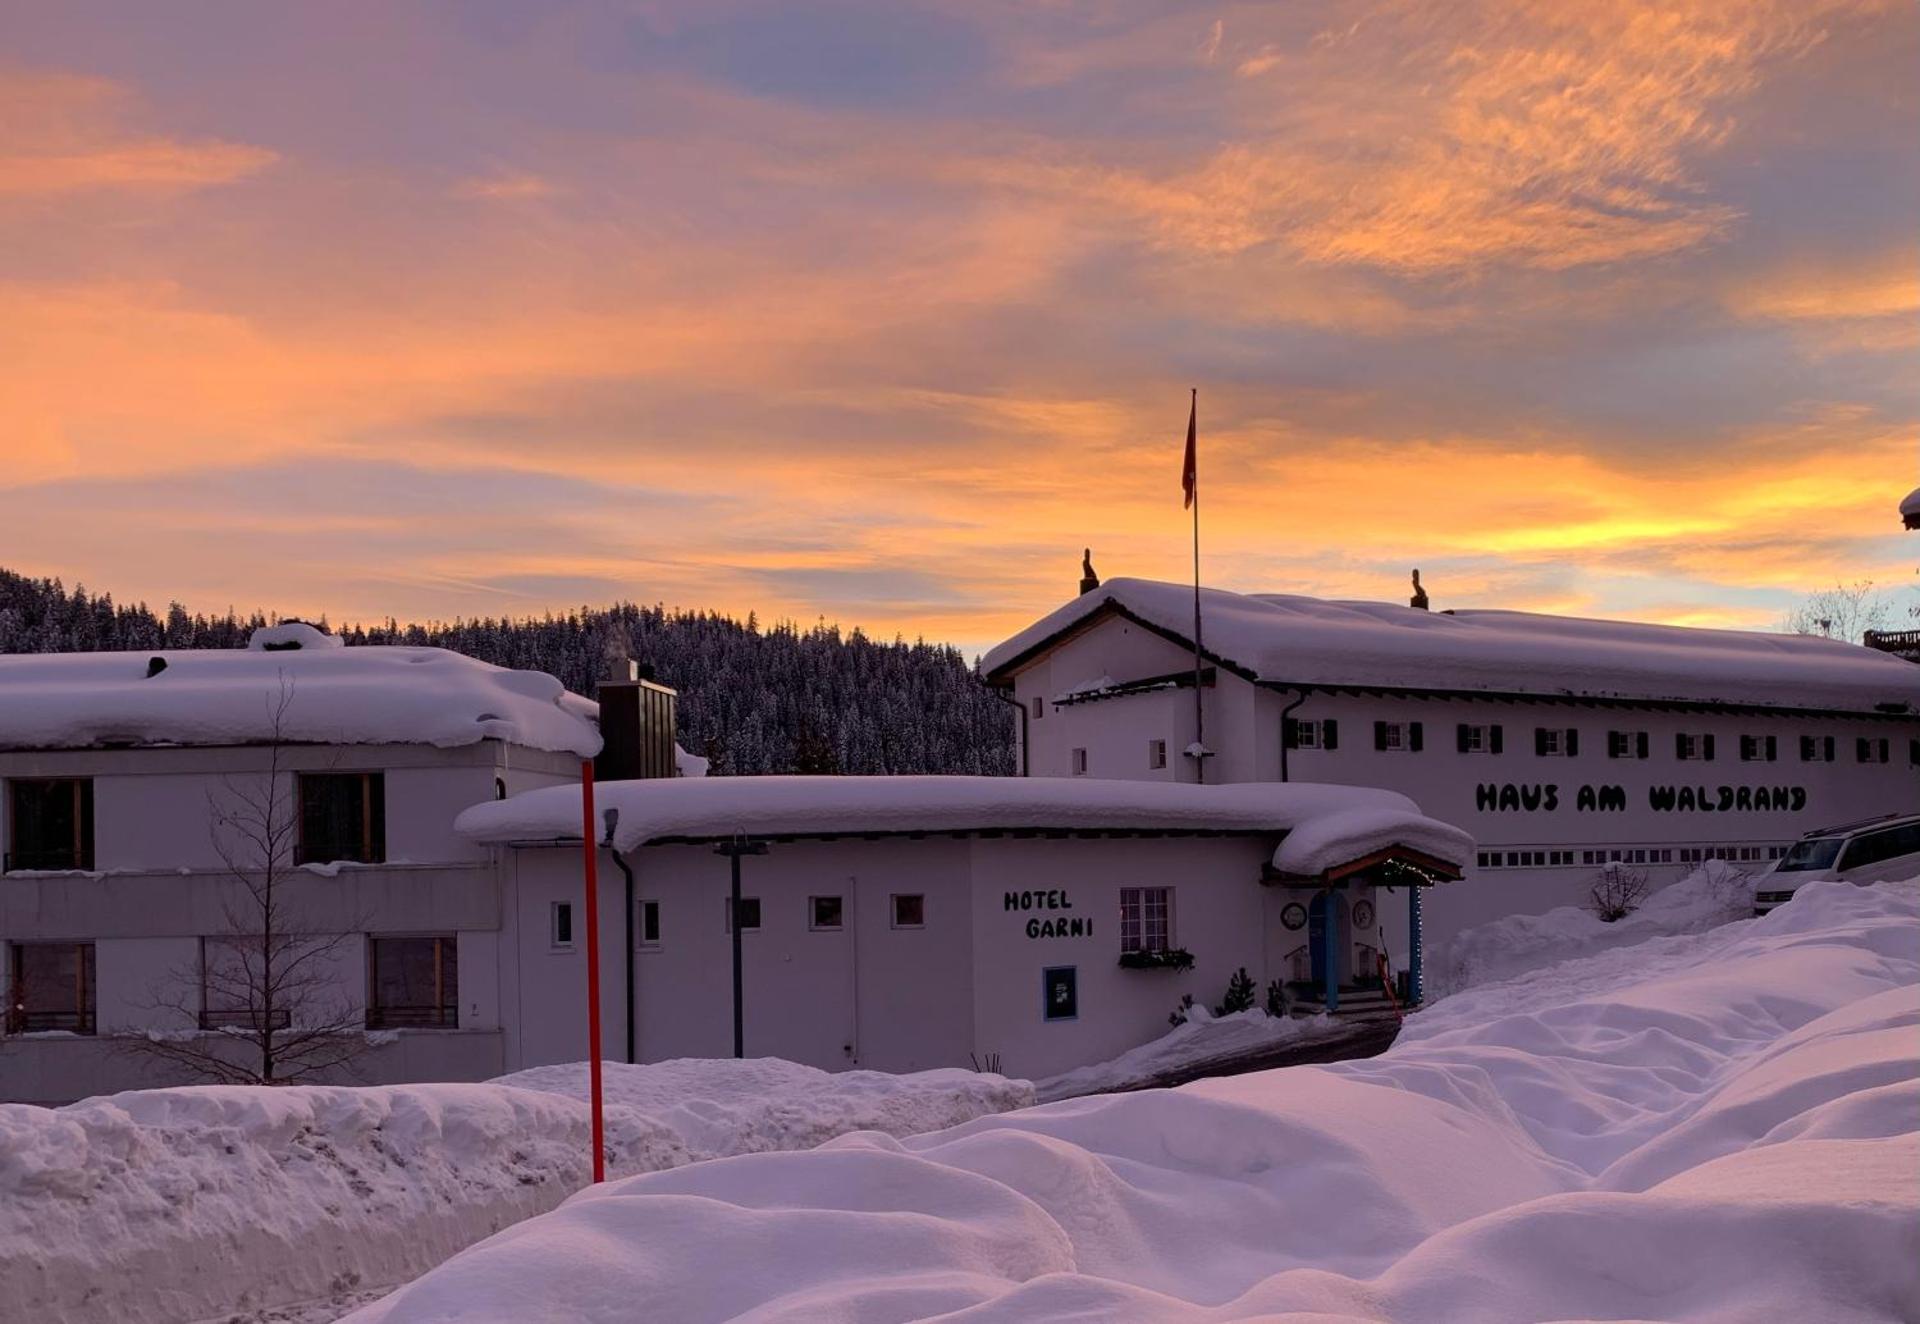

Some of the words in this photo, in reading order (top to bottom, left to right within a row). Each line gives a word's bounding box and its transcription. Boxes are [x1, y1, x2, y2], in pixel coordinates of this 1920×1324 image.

[1476, 783, 1559, 812] HAUS
[1576, 785, 1626, 812] AM
[1649, 785, 1806, 812] WALDRAND
[1004, 889, 1073, 912] HOTEL
[1025, 917, 1093, 939] GARNI
